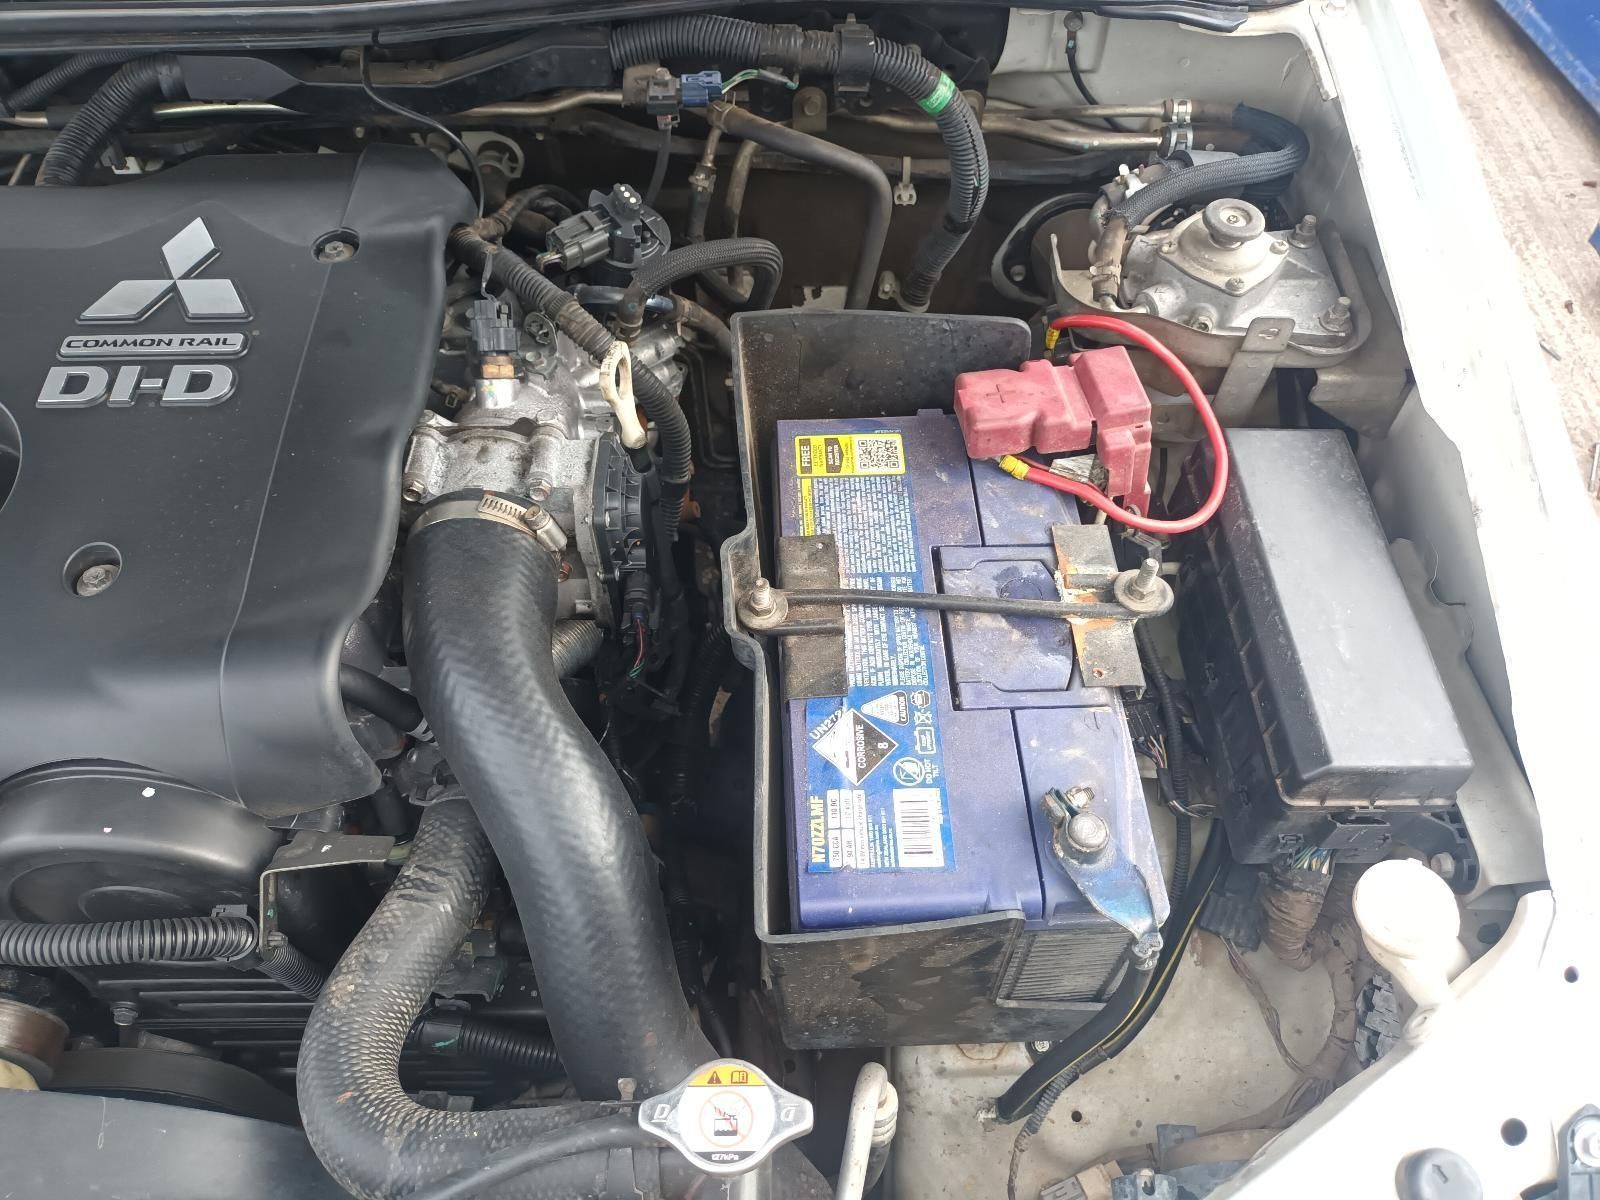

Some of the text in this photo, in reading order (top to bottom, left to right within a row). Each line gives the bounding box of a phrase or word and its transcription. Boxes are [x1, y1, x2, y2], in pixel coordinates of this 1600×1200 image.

[66, 337, 237, 348] COMMON RAIL
[37, 364, 235, 405] DI-D
[801, 445, 810, 467] FREE
[898, 696, 906, 722] CAUTION
[855, 724, 867, 769] CORROSIVE
[877, 741, 889, 749] 8
[923, 759, 933, 784] DO NOT
[810, 796, 826, 863] N70ZZLMF
[831, 836, 840, 849] CCA
